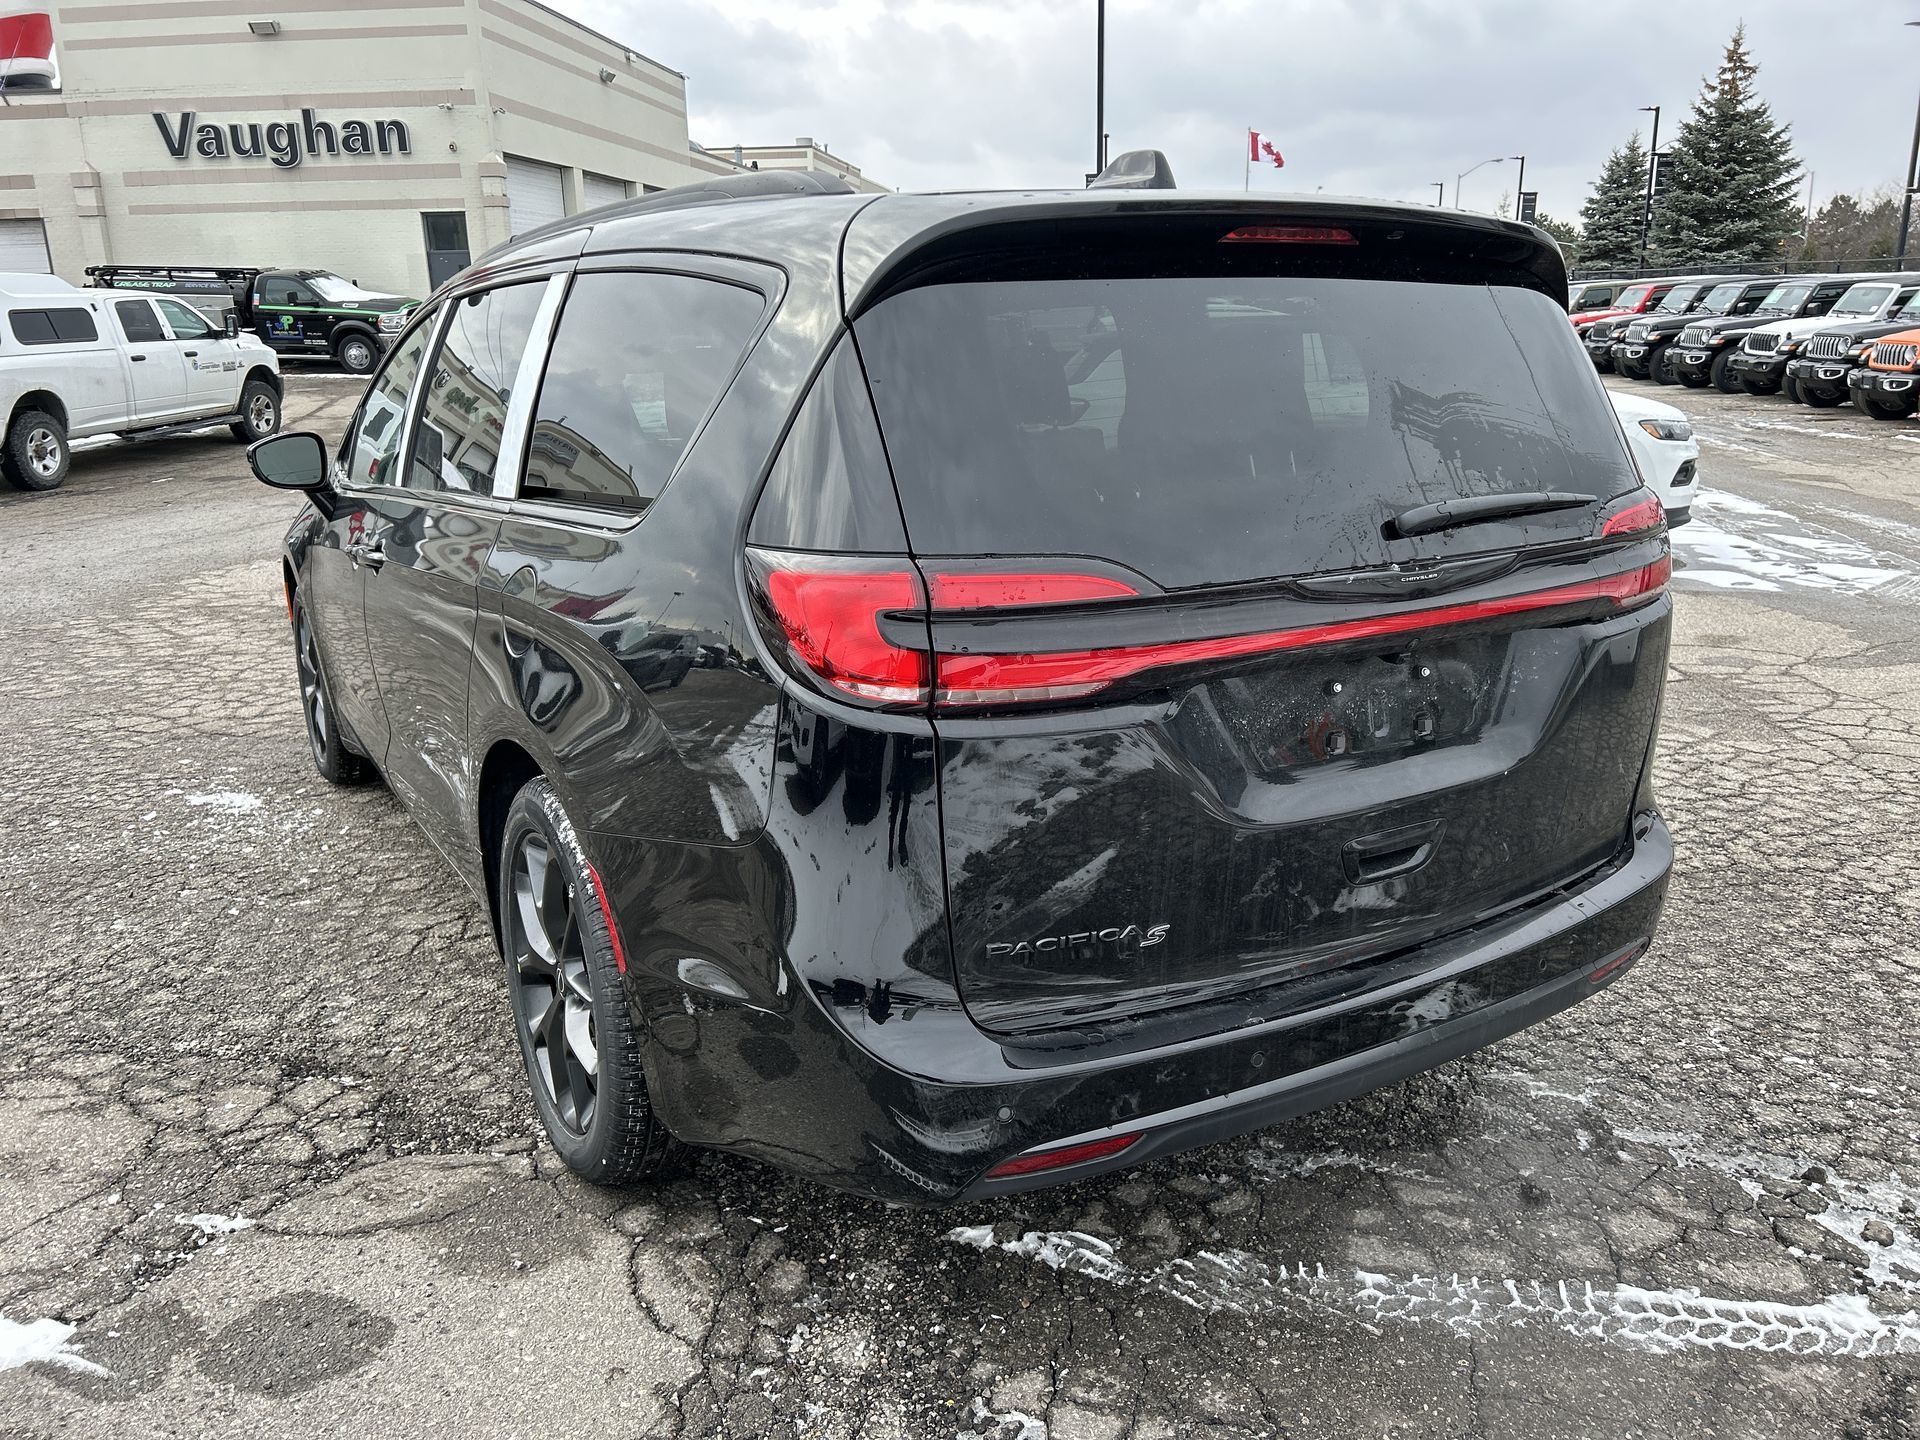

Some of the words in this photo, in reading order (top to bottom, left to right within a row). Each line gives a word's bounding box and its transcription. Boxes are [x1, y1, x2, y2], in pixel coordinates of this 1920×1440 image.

[152, 108, 412, 168] Vaughan
[113, 280, 150, 288] GREASE
[1401, 573, 1438, 582] CHRYSLER
[985, 925, 1144, 956] PACIFICA
[1139, 923, 1171, 948] S
